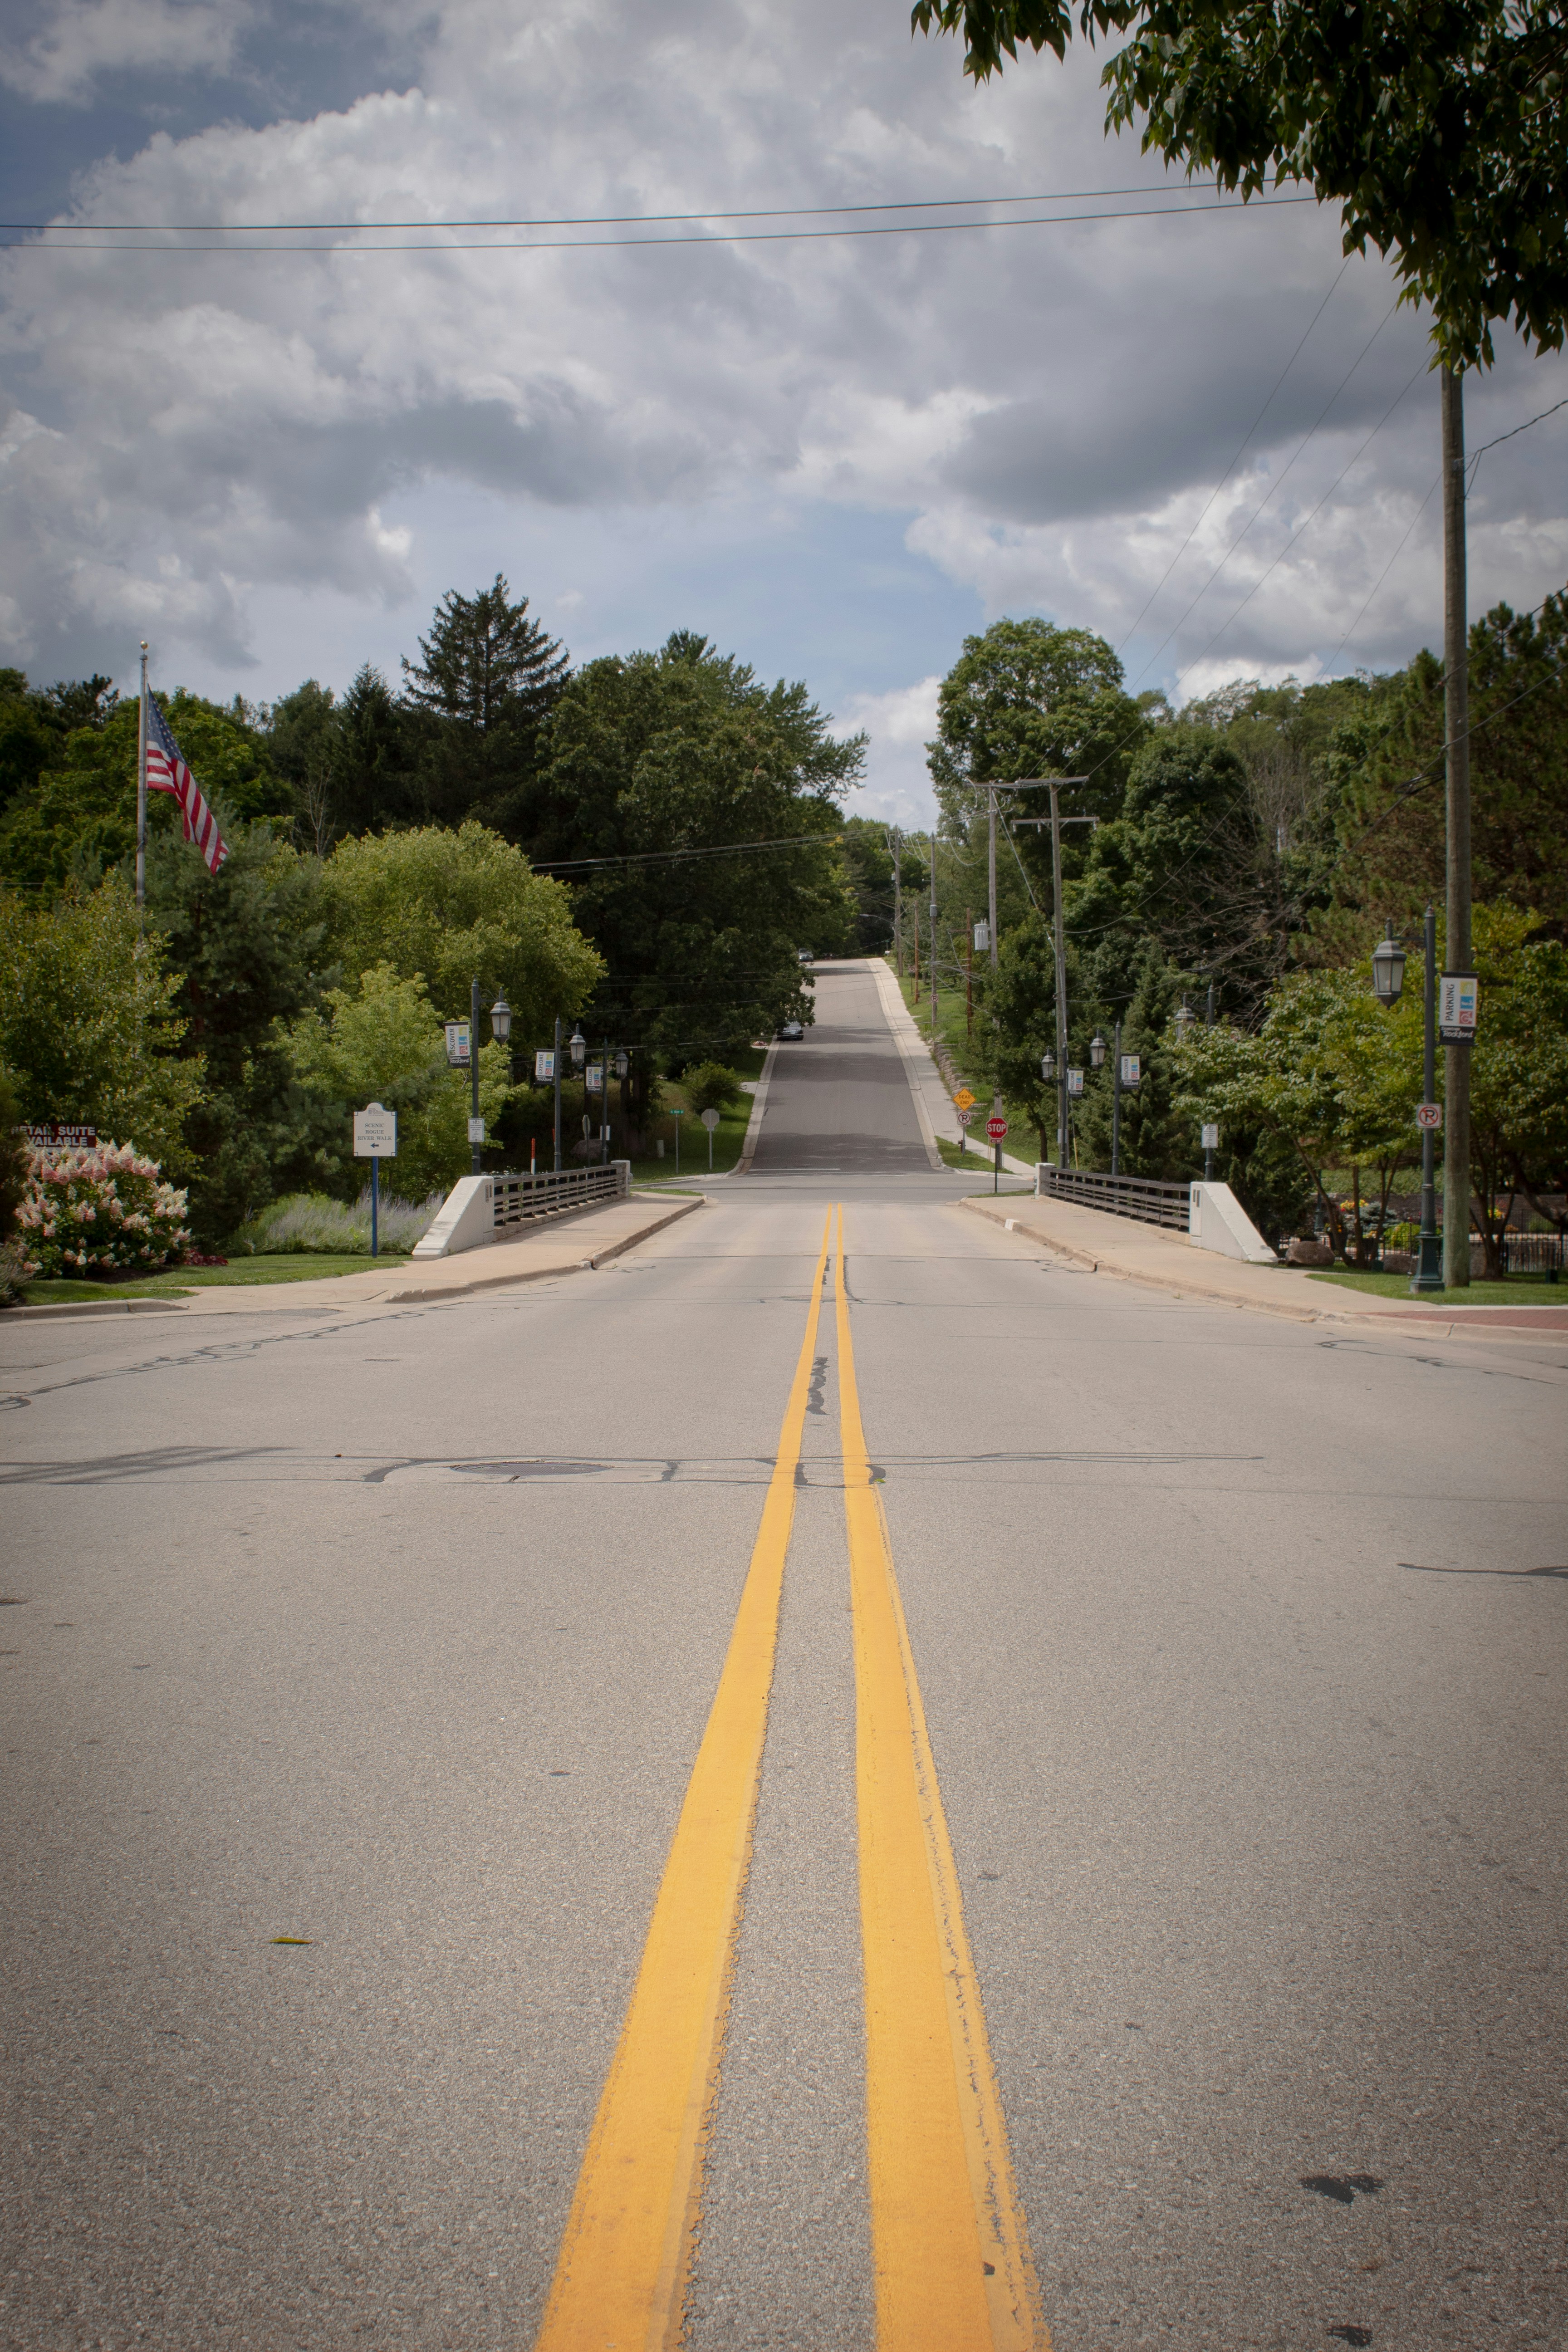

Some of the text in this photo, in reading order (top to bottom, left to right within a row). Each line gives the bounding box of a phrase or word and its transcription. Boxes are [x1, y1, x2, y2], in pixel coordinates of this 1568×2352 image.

[1446, 984, 1455, 1021] PARKING
[58, 1126, 95, 1136] SUITE
[987, 1124, 1006, 1132] STOP
[27, 1136, 87, 1147] VAILABLE
